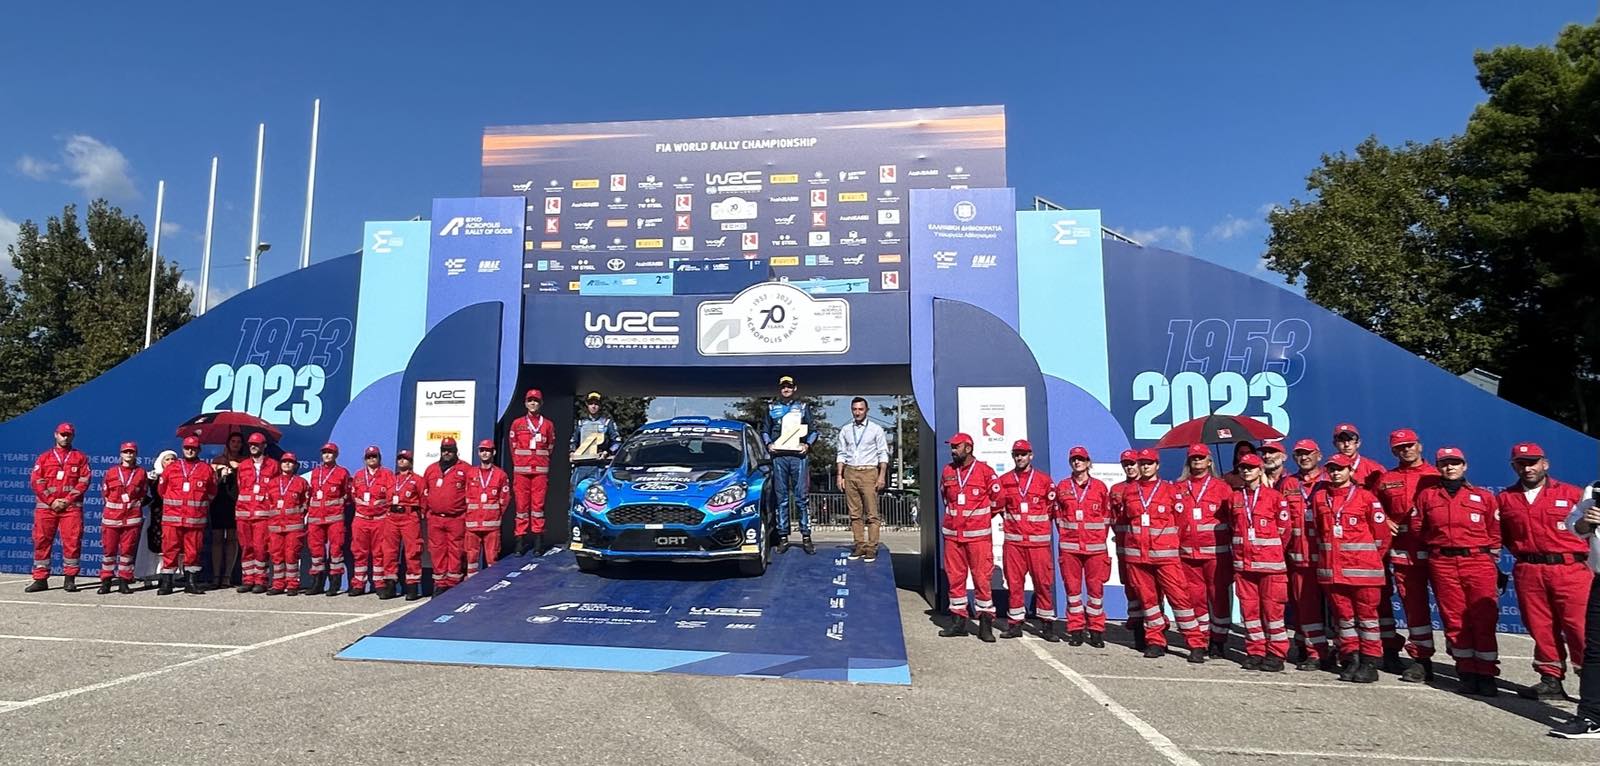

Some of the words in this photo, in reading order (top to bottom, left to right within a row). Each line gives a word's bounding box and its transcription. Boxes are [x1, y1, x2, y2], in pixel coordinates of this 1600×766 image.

[655, 143, 672, 153] FIA
[673, 142, 708, 152] WORLD
[709, 140, 740, 151] RALLY
[742, 138, 817, 149] CHAMPIONSHIP
[705, 170, 763, 186] WRC
[753, 293, 768, 306] 1953
[584, 311, 680, 332] WRC
[760, 305, 786, 330] 70
[746, 316, 783, 344] ACROPOLIS
[783, 316, 799, 339] RALLY
[228, 317, 353, 379] 1953
[1161, 318, 1312, 388] 1953
[201, 363, 326, 427] 2023
[425, 390, 466, 400] WRC
[1132, 371, 1290, 441] 2023
[3, 453, 29, 461] YEARS
[144, 457, 155, 465] TH
[4, 467, 17, 475] THE
[15, 495, 35, 503] LEGE
[0, 508, 21, 516] EARS
[23, 509, 33, 517] TH
[0, 522, 9, 530] HE
[8, 550, 32, 559] LEGEN
[1512, 624, 1527, 633] TH
